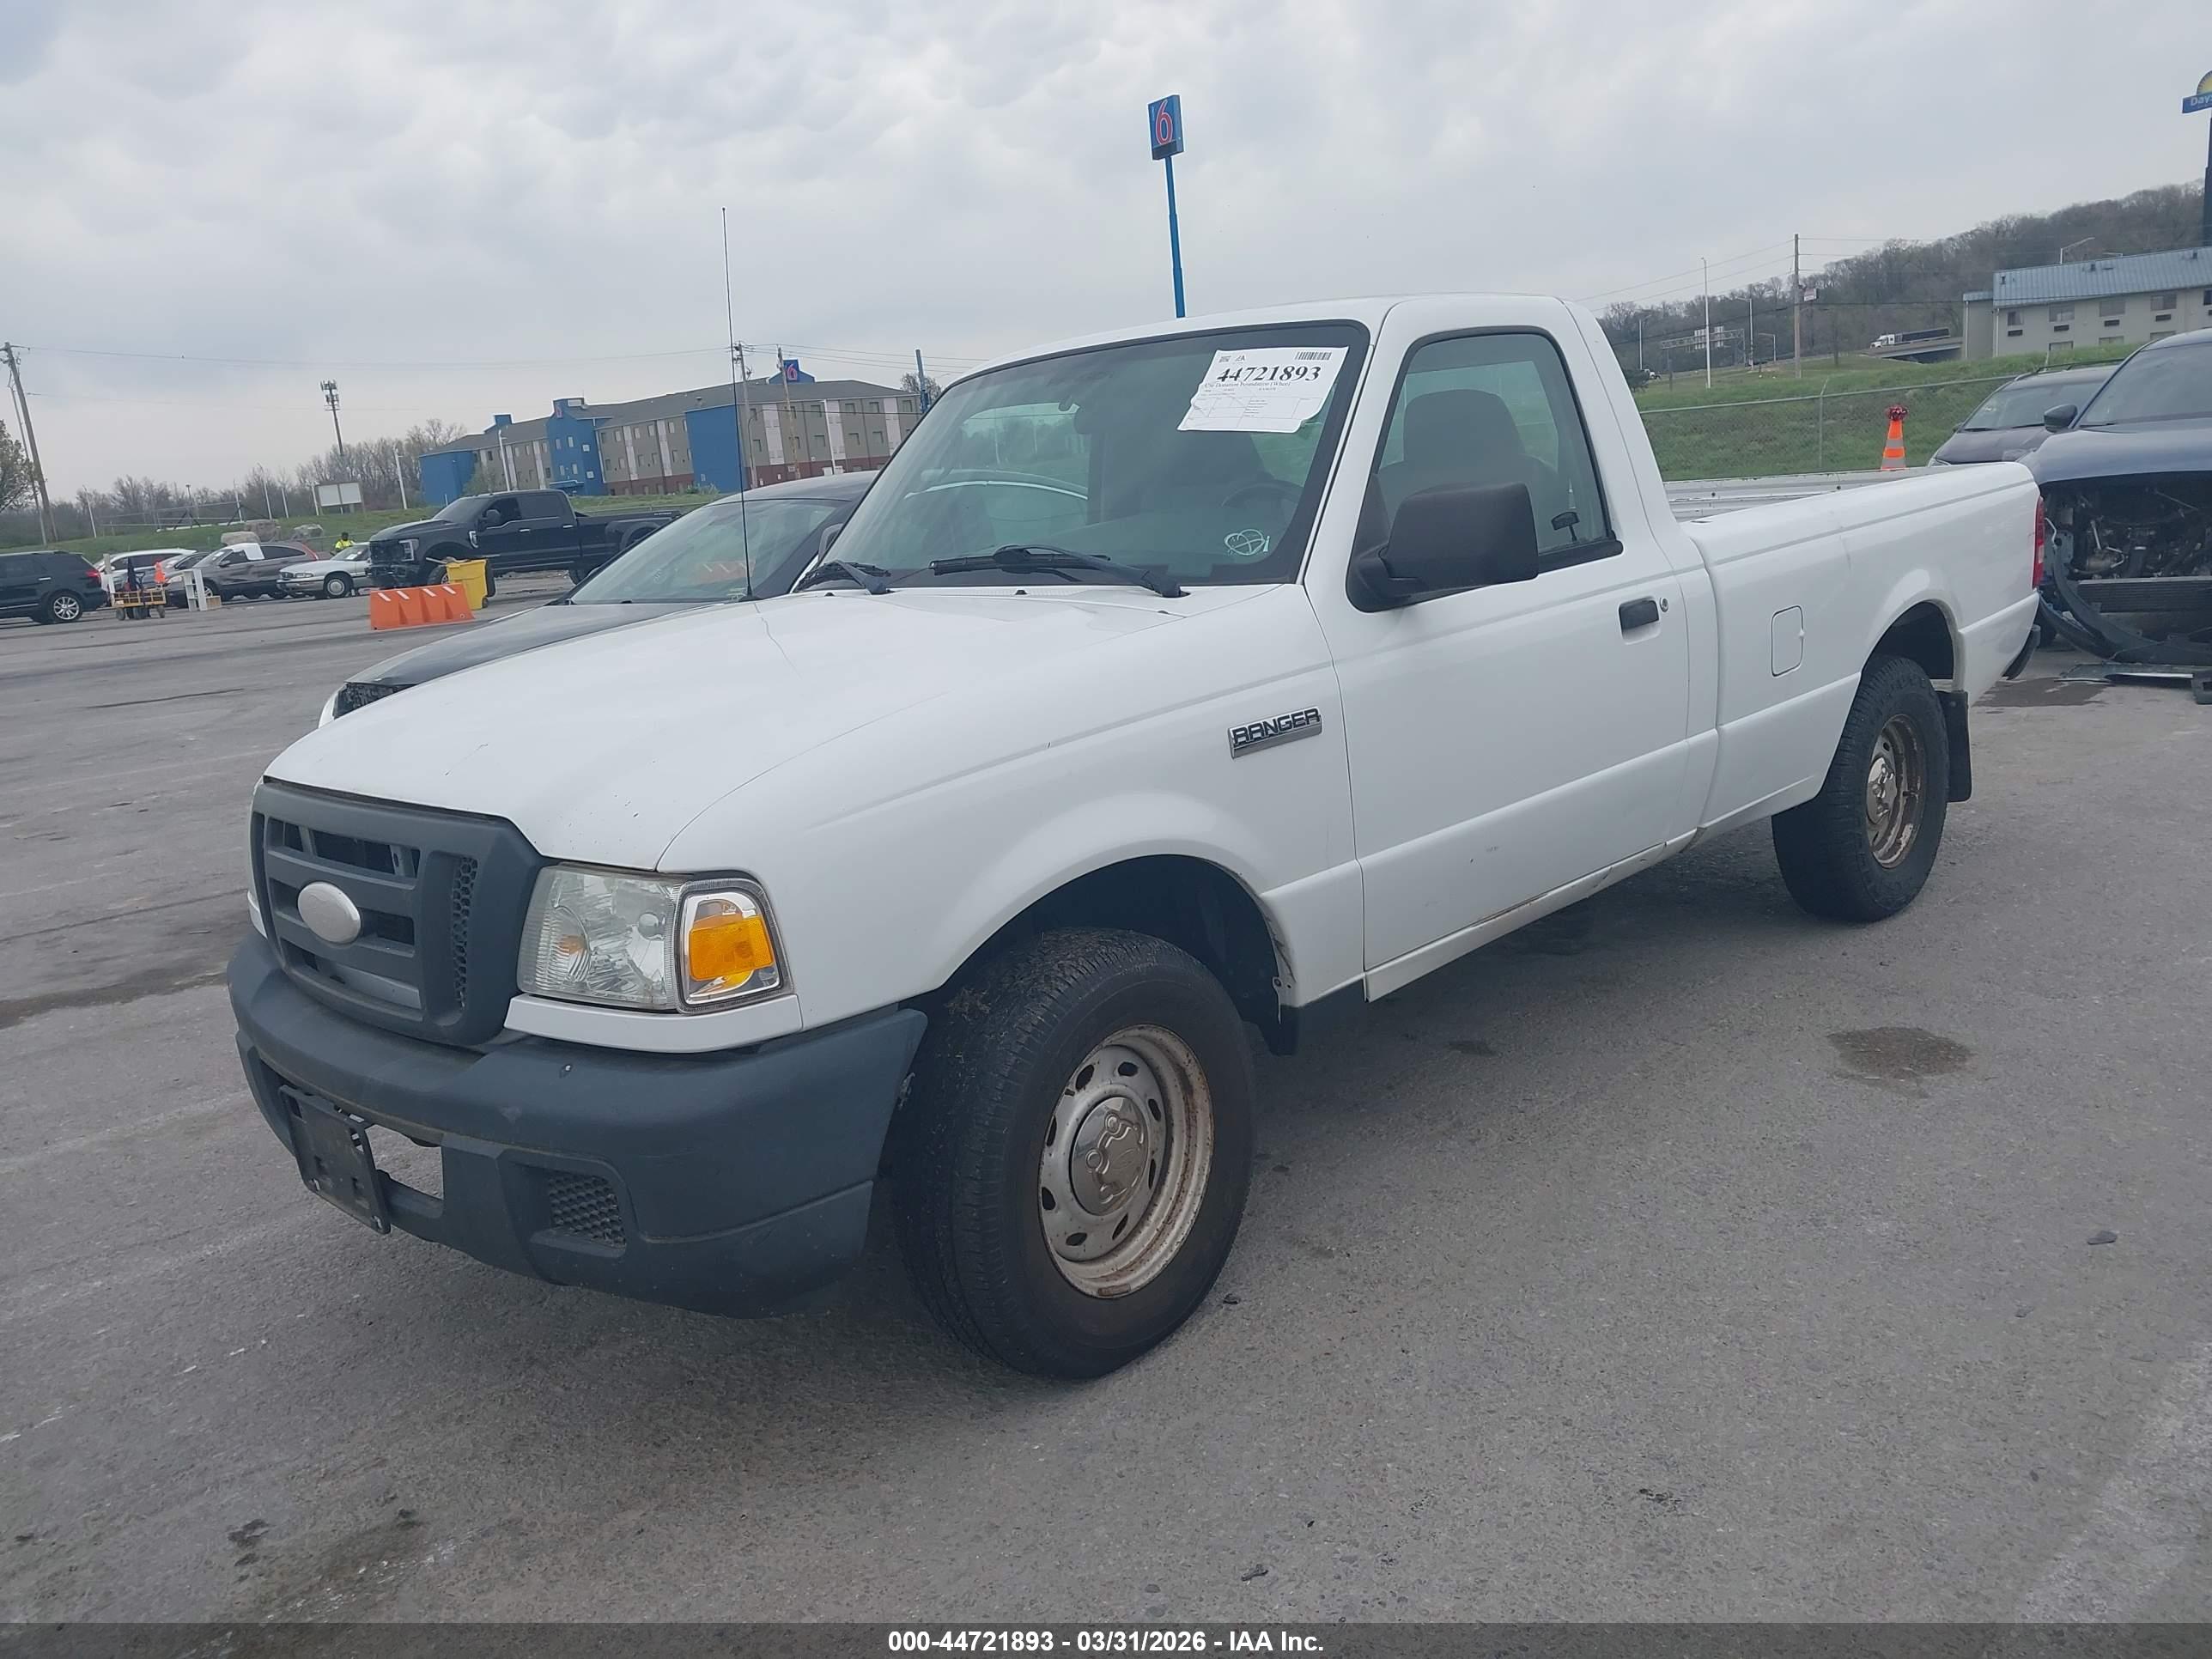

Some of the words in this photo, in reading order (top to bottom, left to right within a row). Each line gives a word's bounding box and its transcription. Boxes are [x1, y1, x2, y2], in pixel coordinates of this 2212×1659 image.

[1155, 99, 1173, 145] 6
[787, 363, 797, 380] 6
[1217, 366, 1321, 382] 44721893
[1232, 708, 1320, 744] RANGER
